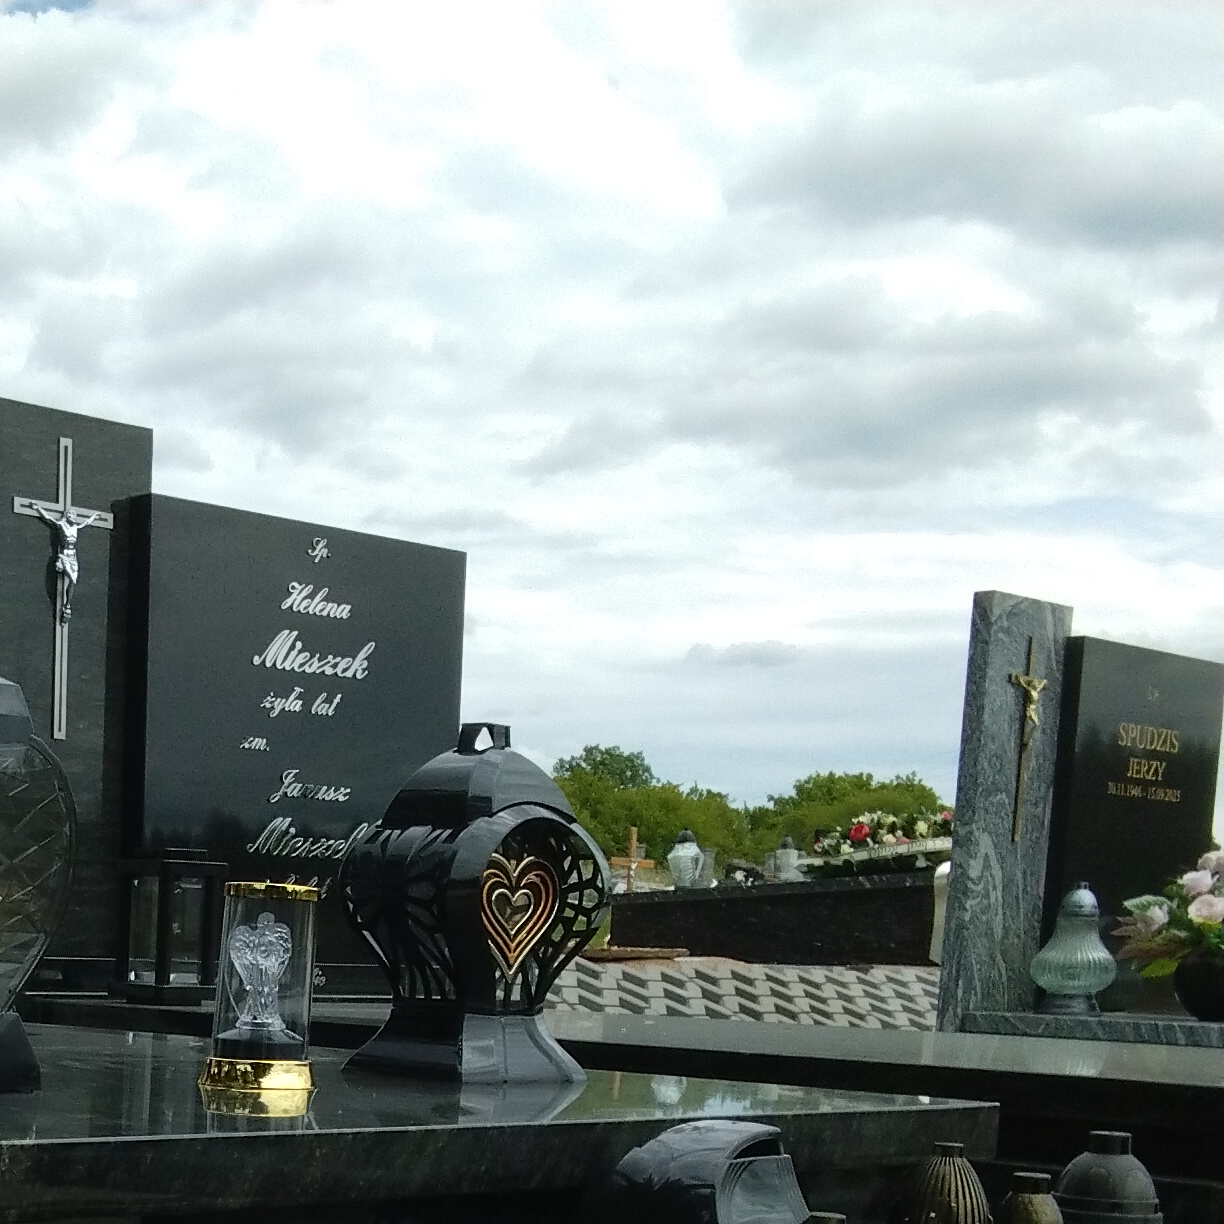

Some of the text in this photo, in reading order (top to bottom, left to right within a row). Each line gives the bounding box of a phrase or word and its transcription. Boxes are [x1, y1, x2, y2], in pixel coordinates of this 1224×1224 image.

[281, 581, 352, 620] Helena
[252, 629, 376, 680] Mieszek
[259, 687, 343, 718] żyła lat
[239, 735, 270, 751] zm.
[1118, 722, 1180, 753] SPUDZIS
[1126, 756, 1166, 781] JERZY
[268, 768, 352, 803] Janusz
